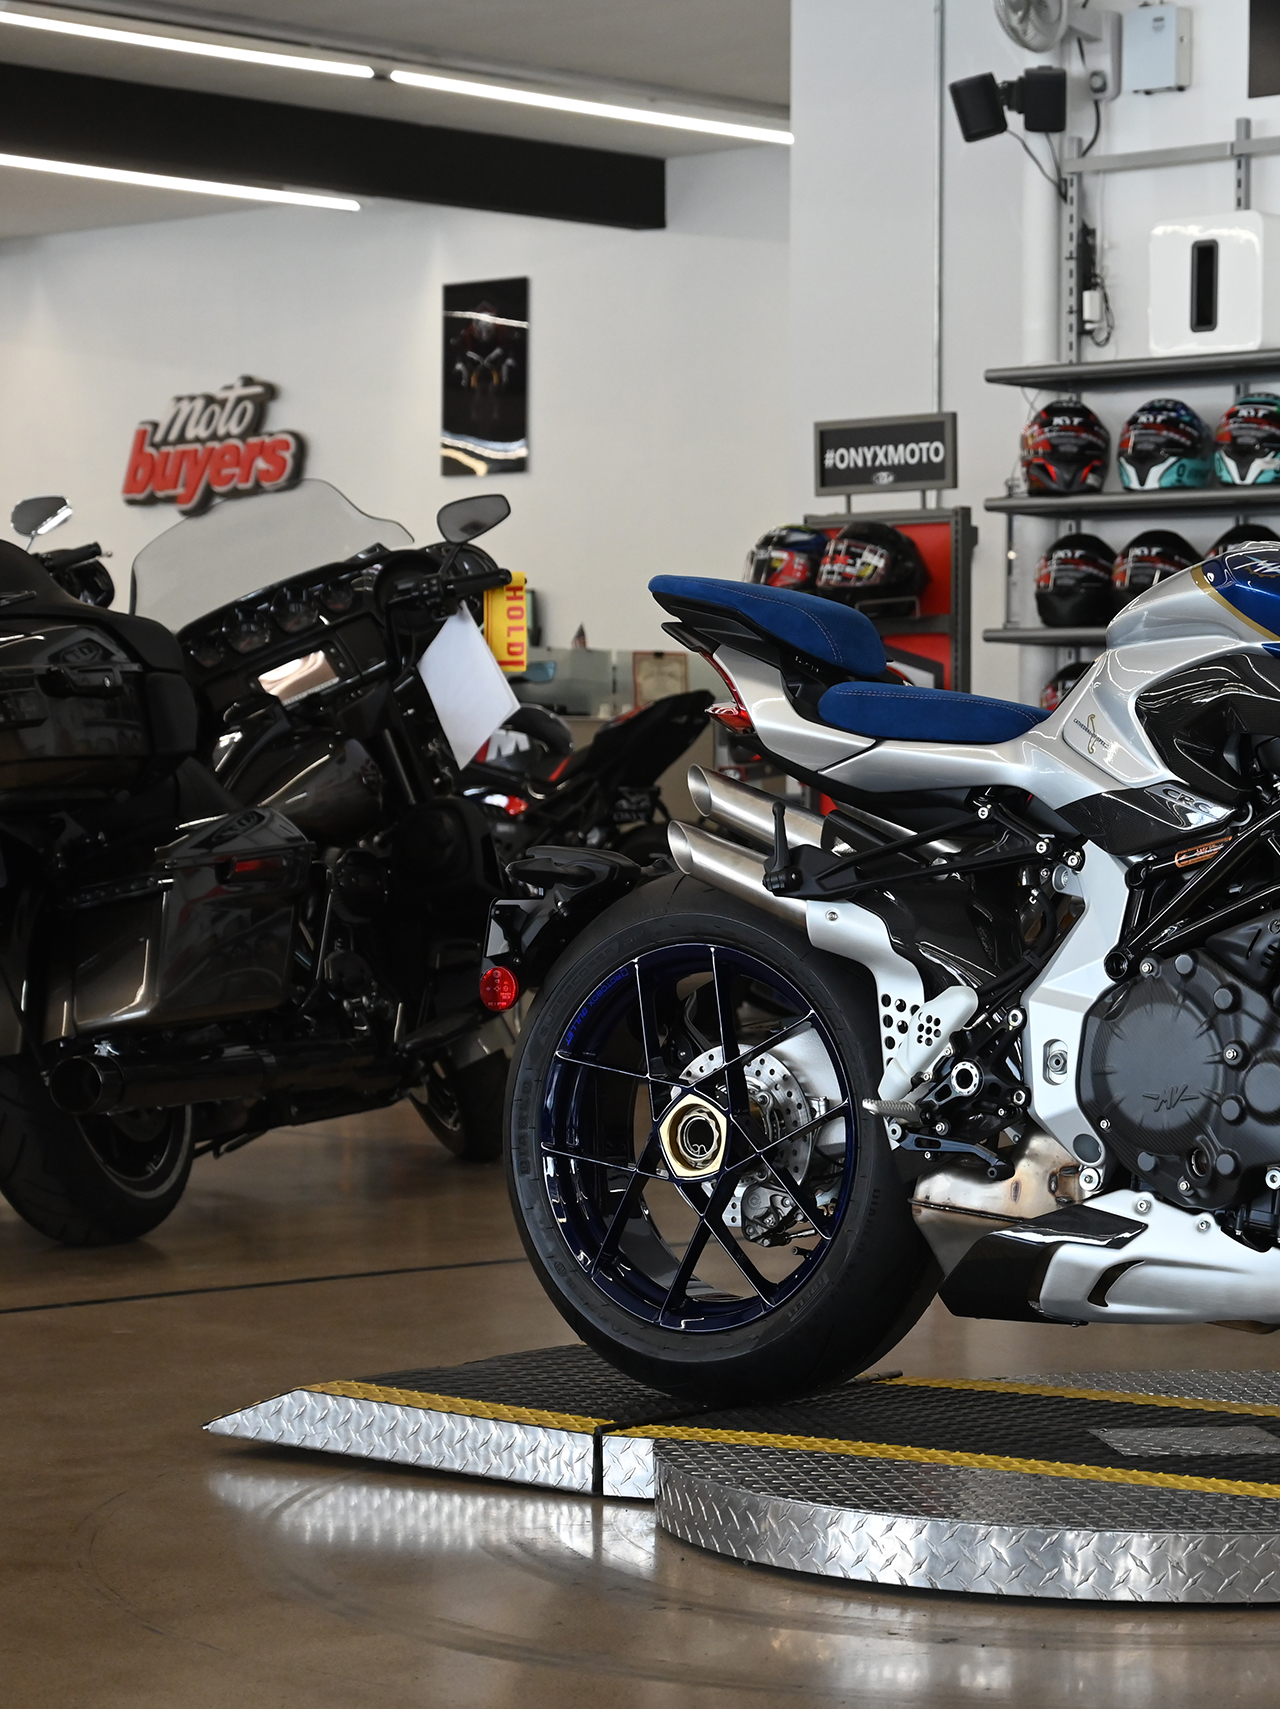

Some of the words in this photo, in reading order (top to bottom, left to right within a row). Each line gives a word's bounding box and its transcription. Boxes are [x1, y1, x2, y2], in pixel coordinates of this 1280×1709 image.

[1052, 416, 1084, 426] KYT
[122, 425, 294, 509] buyers
[824, 441, 945, 469] #ONYXMOTO
[588, 974, 622, 1006] ROTOBOX
[565, 1007, 588, 1046] BULLET
